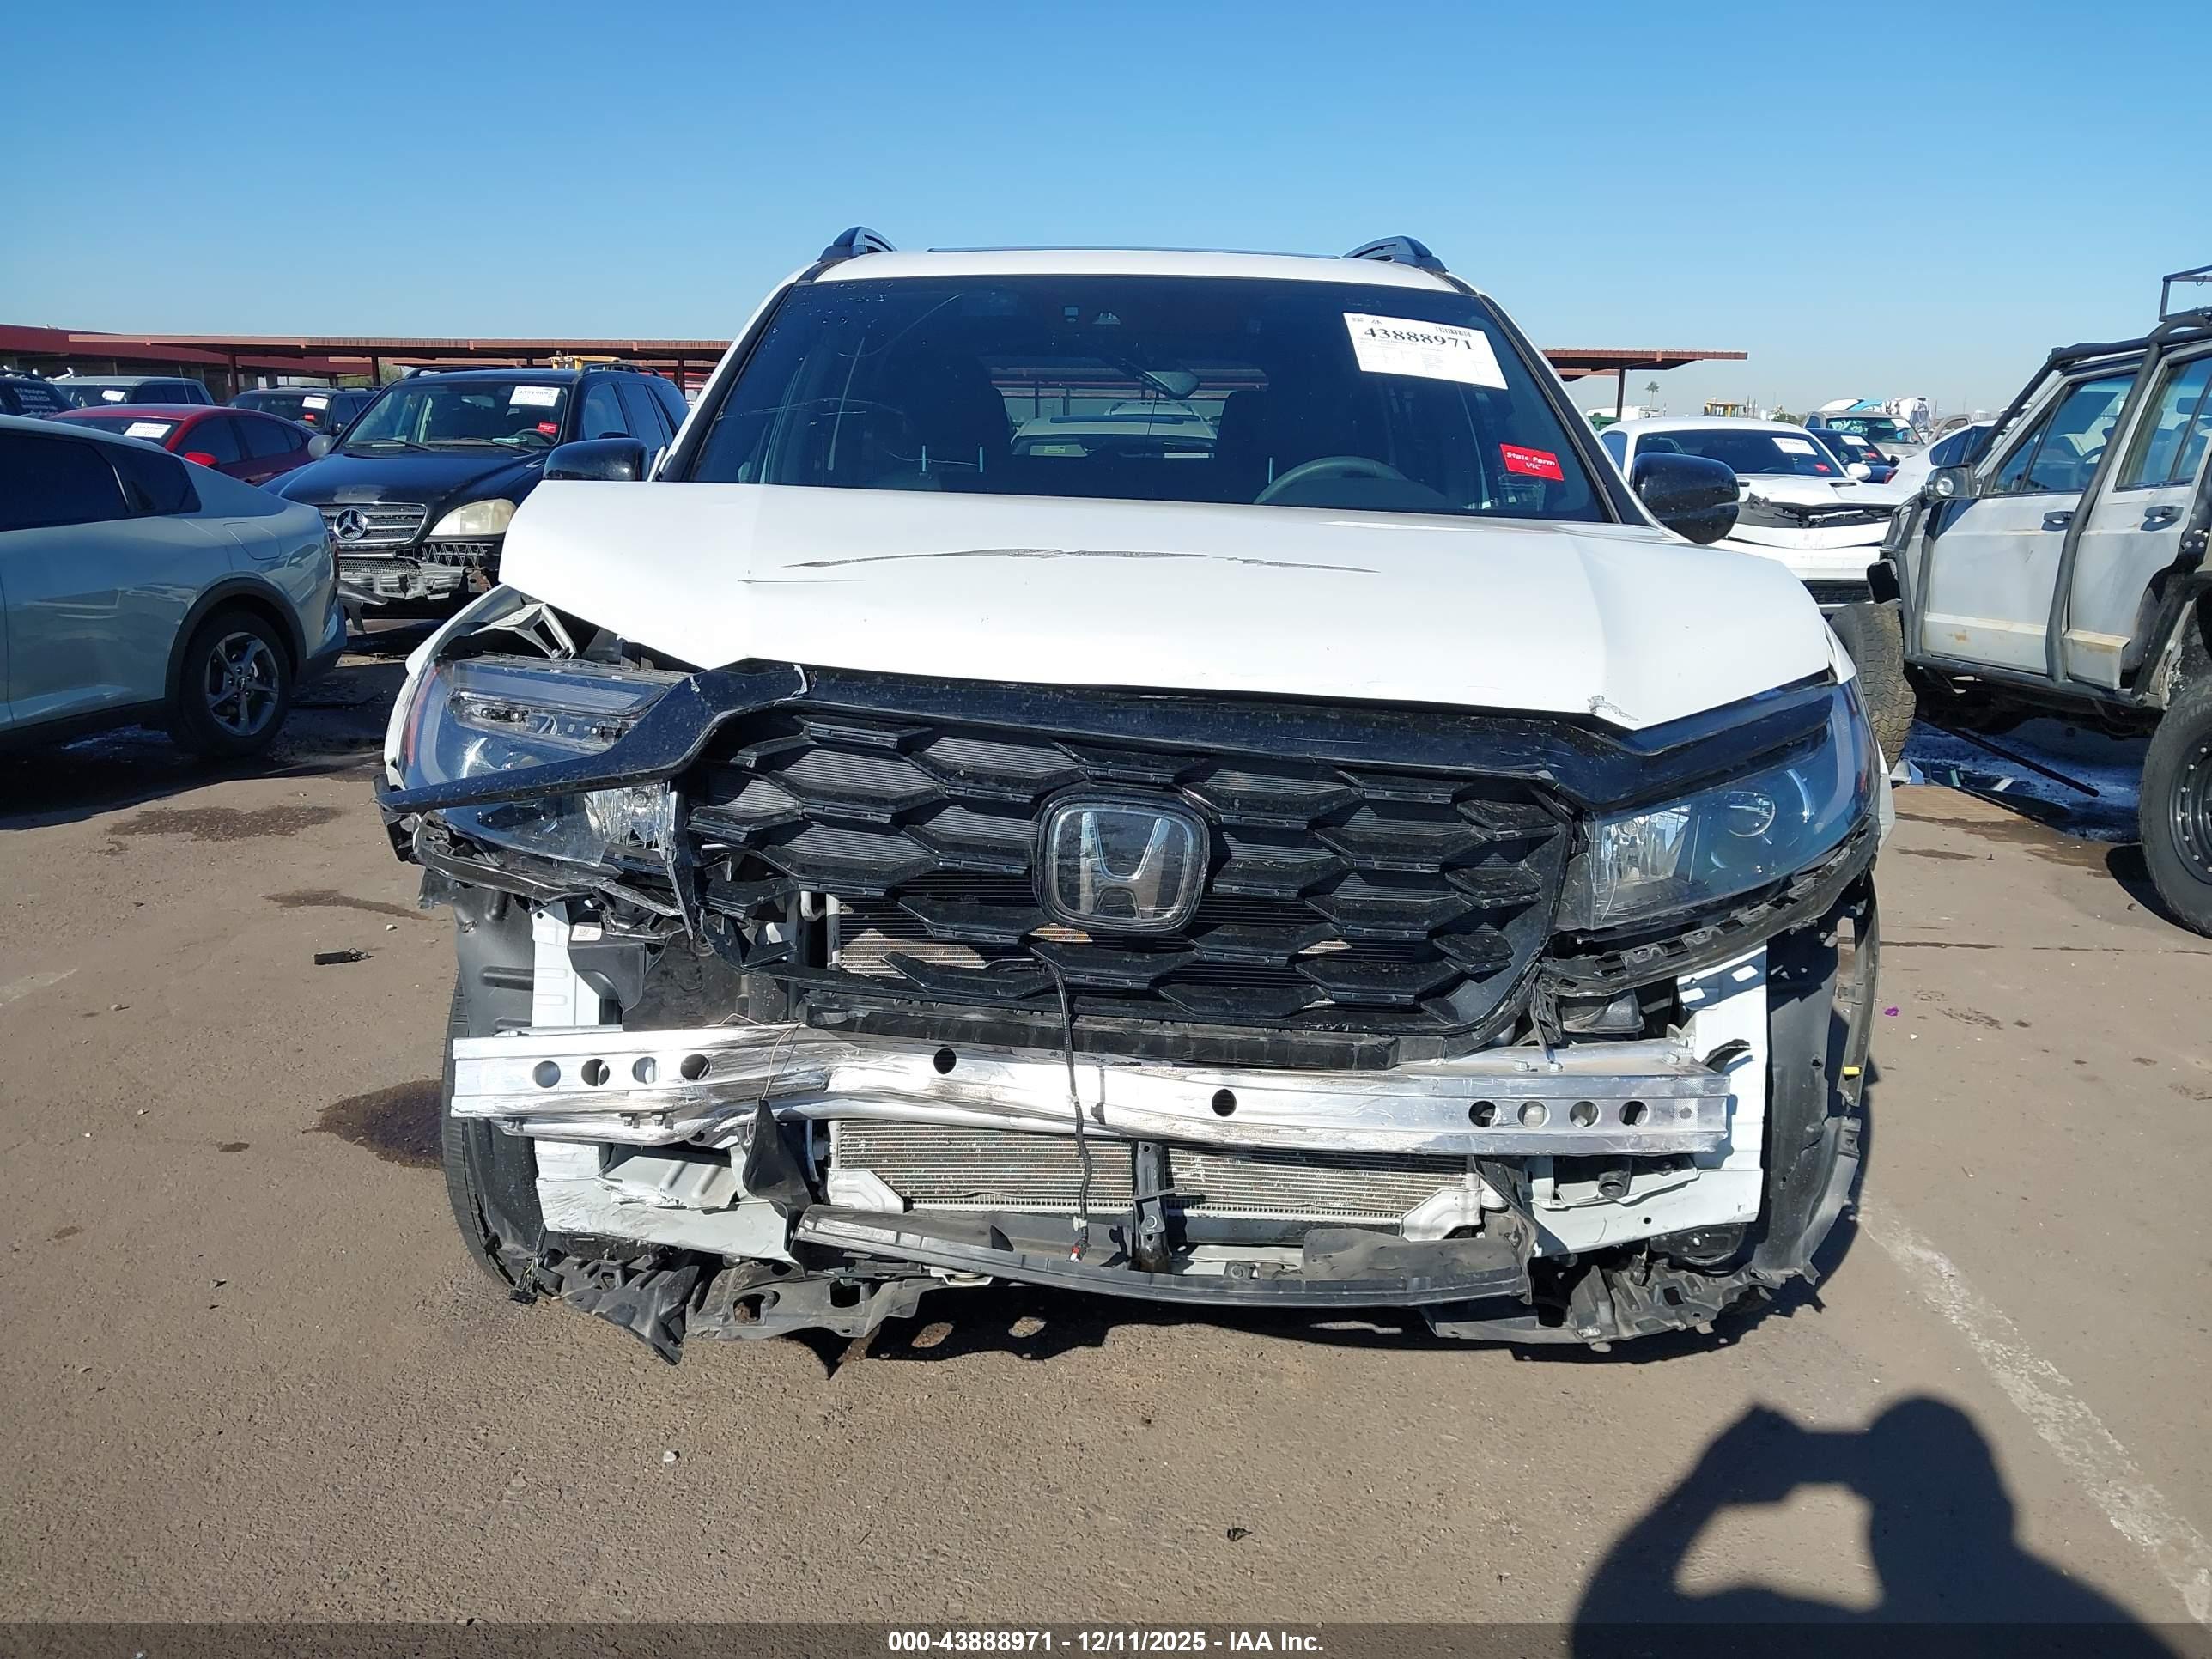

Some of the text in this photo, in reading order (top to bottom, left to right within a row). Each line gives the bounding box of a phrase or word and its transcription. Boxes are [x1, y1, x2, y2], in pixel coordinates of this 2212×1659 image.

[1364, 327, 1474, 350] 43888971
[1506, 452, 1556, 466] State Farm
